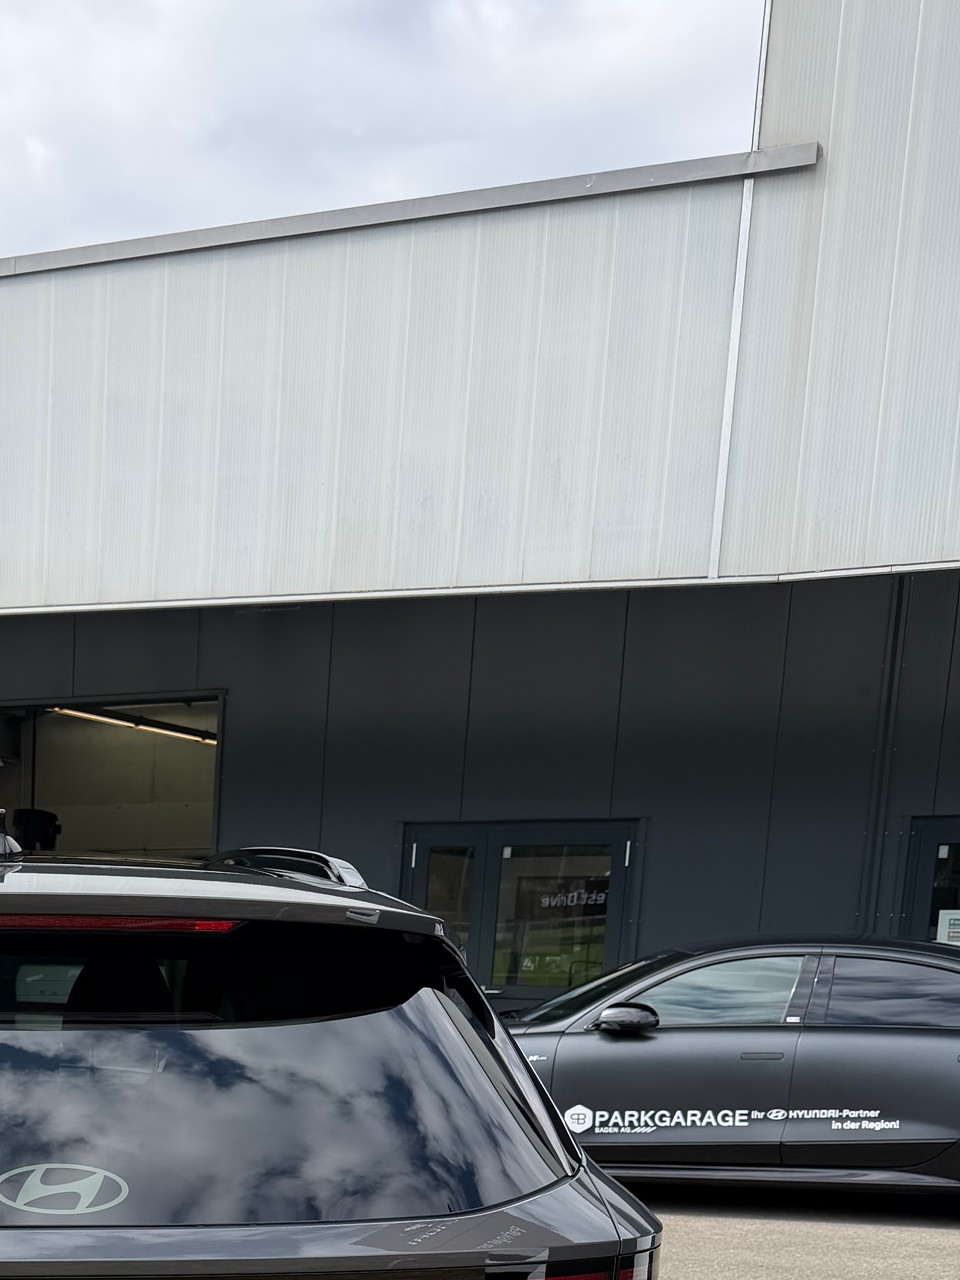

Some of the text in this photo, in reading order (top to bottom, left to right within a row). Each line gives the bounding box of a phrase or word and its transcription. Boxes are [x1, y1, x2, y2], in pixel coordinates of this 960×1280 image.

[594, 1109, 749, 1127] PARKGARAGE
[751, 1110, 765, 1119] Ihr
[594, 1126, 632, 1134] BADEN AG
[831, 1119, 900, 1131] in der Region!
